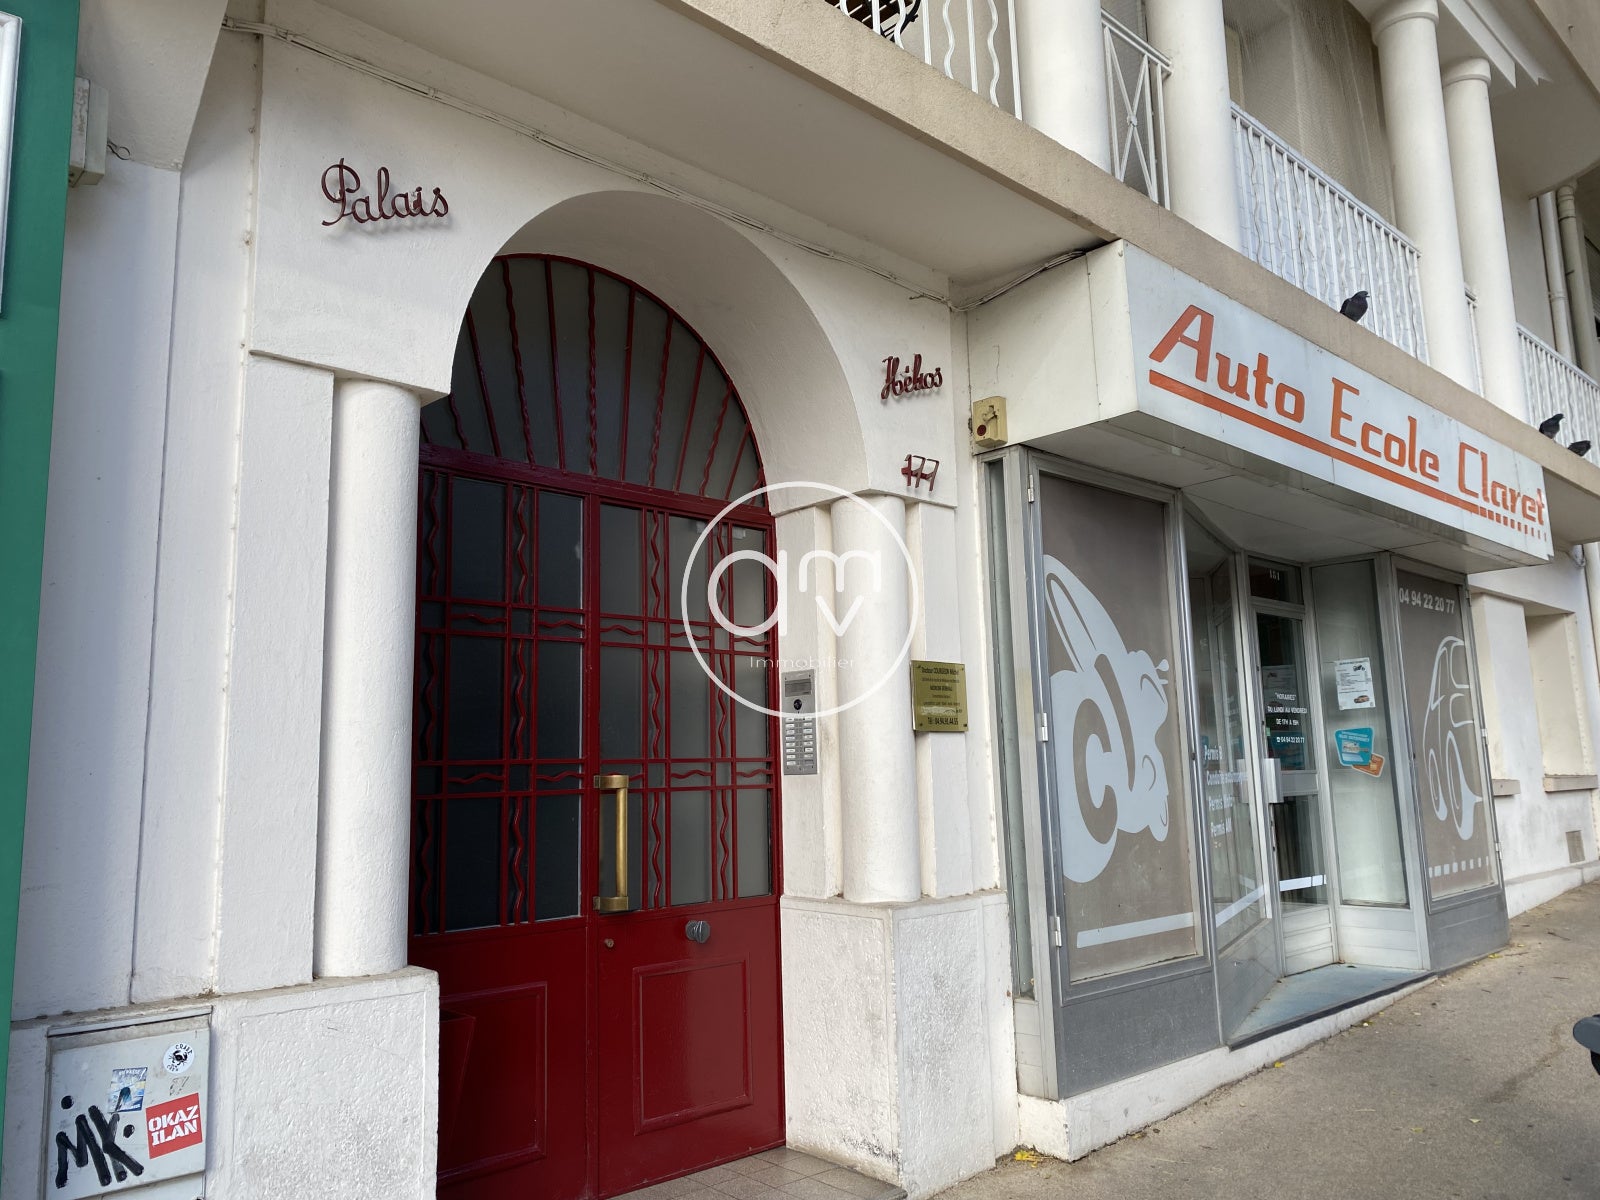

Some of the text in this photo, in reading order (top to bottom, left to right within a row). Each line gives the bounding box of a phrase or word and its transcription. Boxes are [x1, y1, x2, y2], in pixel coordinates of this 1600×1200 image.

[321, 158, 449, 226] Palais
[1149, 304, 1544, 525] Auto Ecole Claret
[901, 454, 940, 492] 177
[1399, 587, 1455, 614] 04 94 22 20 77
[148, 1104, 199, 1132] OKAZ
[151, 1118, 197, 1146] ILAN
